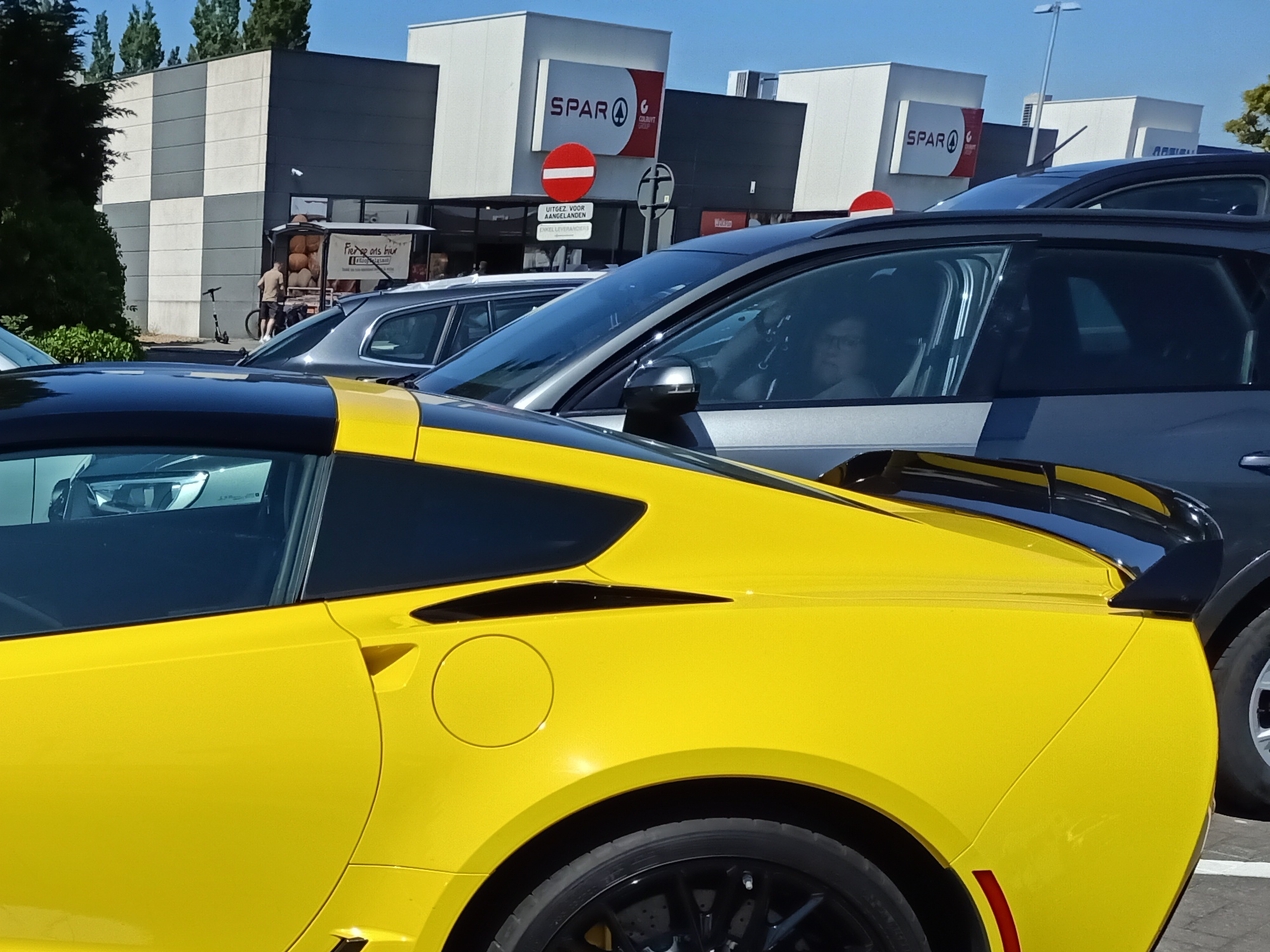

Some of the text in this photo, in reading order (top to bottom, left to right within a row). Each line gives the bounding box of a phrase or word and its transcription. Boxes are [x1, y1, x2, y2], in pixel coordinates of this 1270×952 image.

[550, 97, 608, 119] SPAR
[907, 130, 945, 148] SPAR
[370, 247, 381, 255] ons
